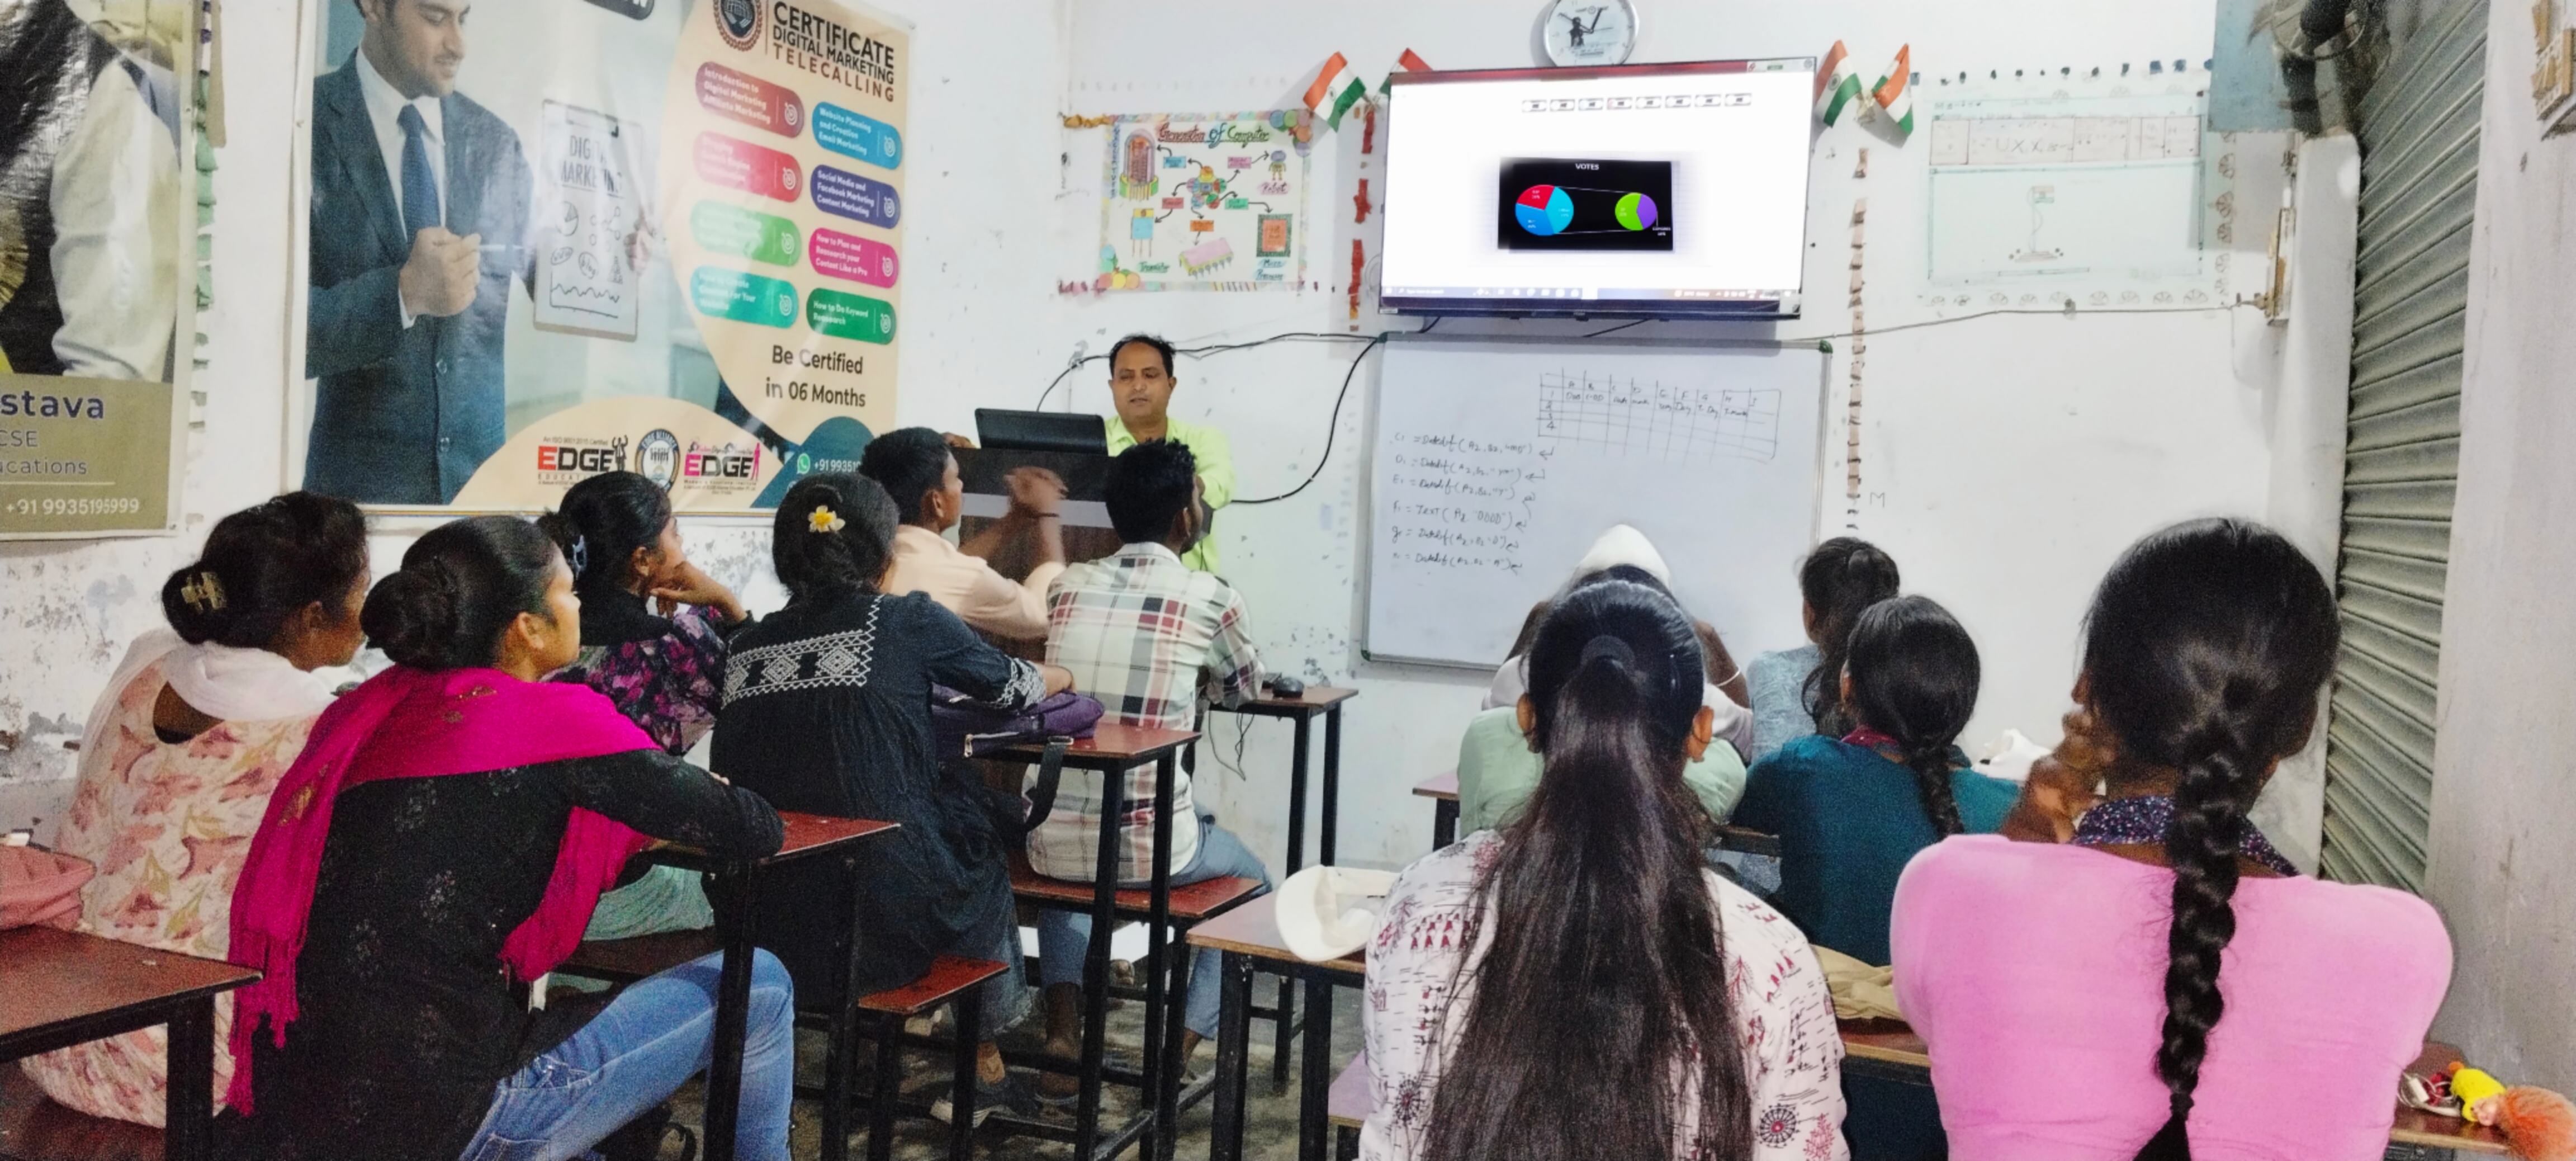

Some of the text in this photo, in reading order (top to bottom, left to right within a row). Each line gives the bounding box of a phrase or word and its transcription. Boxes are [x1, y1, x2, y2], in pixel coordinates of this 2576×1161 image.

[774, 1, 894, 69] CERTIFICATE
[773, 25, 894, 85] DIGITAL MARKETING
[773, 42, 894, 102] TELECALLING
[836, 137, 867, 156] Marketing
[1209, 122, 1227, 149] of
[817, 170, 836, 182] Social
[837, 176, 855, 188] Media
[817, 182, 875, 207] Facebook Marketing
[817, 195, 869, 218] Content Marketing
[816, 234, 829, 244] How
[816, 257, 839, 270] Content
[858, 267, 868, 276] Pro
[813, 300, 827, 310] How
[836, 304, 845, 313] Do
[846, 306, 868, 318] Keyword
[773, 344, 863, 375] Be Certified
[766, 377, 865, 407] in 06 Months
[0, 390, 105, 419] stava
[1546, 421, 1556, 431] 4
[0, 457, 87, 475] cations
[538, 446, 615, 472] EDGE
[684, 454, 754, 478] EDGE
[815, 459, 829, 471] +91
[6, 498, 139, 515] +91 9935195999
